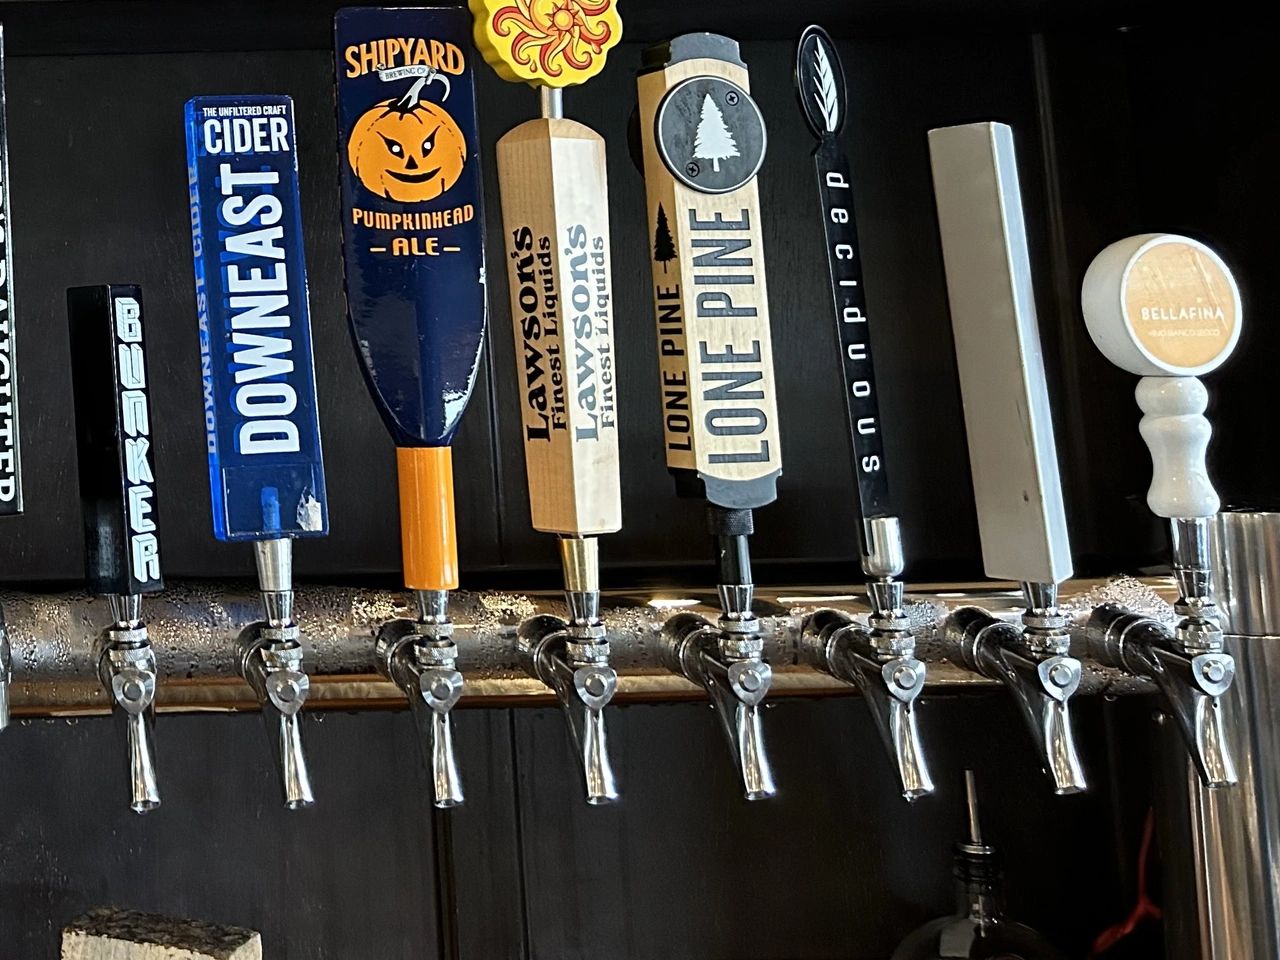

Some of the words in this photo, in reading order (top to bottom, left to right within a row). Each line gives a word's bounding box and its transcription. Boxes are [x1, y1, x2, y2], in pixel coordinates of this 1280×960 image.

[345, 37, 465, 79] SHIPYARD
[385, 66, 416, 81] BREWING
[202, 106, 218, 117] THE
[218, 105, 262, 117] UNFILTERED
[263, 104, 287, 116] CRAFT
[203, 117, 290, 155] CIDER
[187, 166, 203, 258] CIDER
[352, 204, 474, 231] PUMPKINHEAD
[392, 237, 440, 256] ALE
[536, 236, 559, 337] Liquids
[591, 236, 610, 337] Liquids
[688, 208, 758, 318] PINE
[220, 163, 301, 456] DOWNEAST
[511, 226, 551, 443] Lawson's
[564, 224, 599, 443] Lawson's
[656, 284, 685, 357] PINE
[1141, 306, 1225, 321] BELLAFINA
[196, 274, 217, 454] DOWNEAST
[545, 343, 568, 431] Finest
[596, 343, 615, 429] Finest
[698, 340, 770, 464] LONE
[114, 297, 161, 584] BUNKER
[663, 370, 692, 452] LONE
